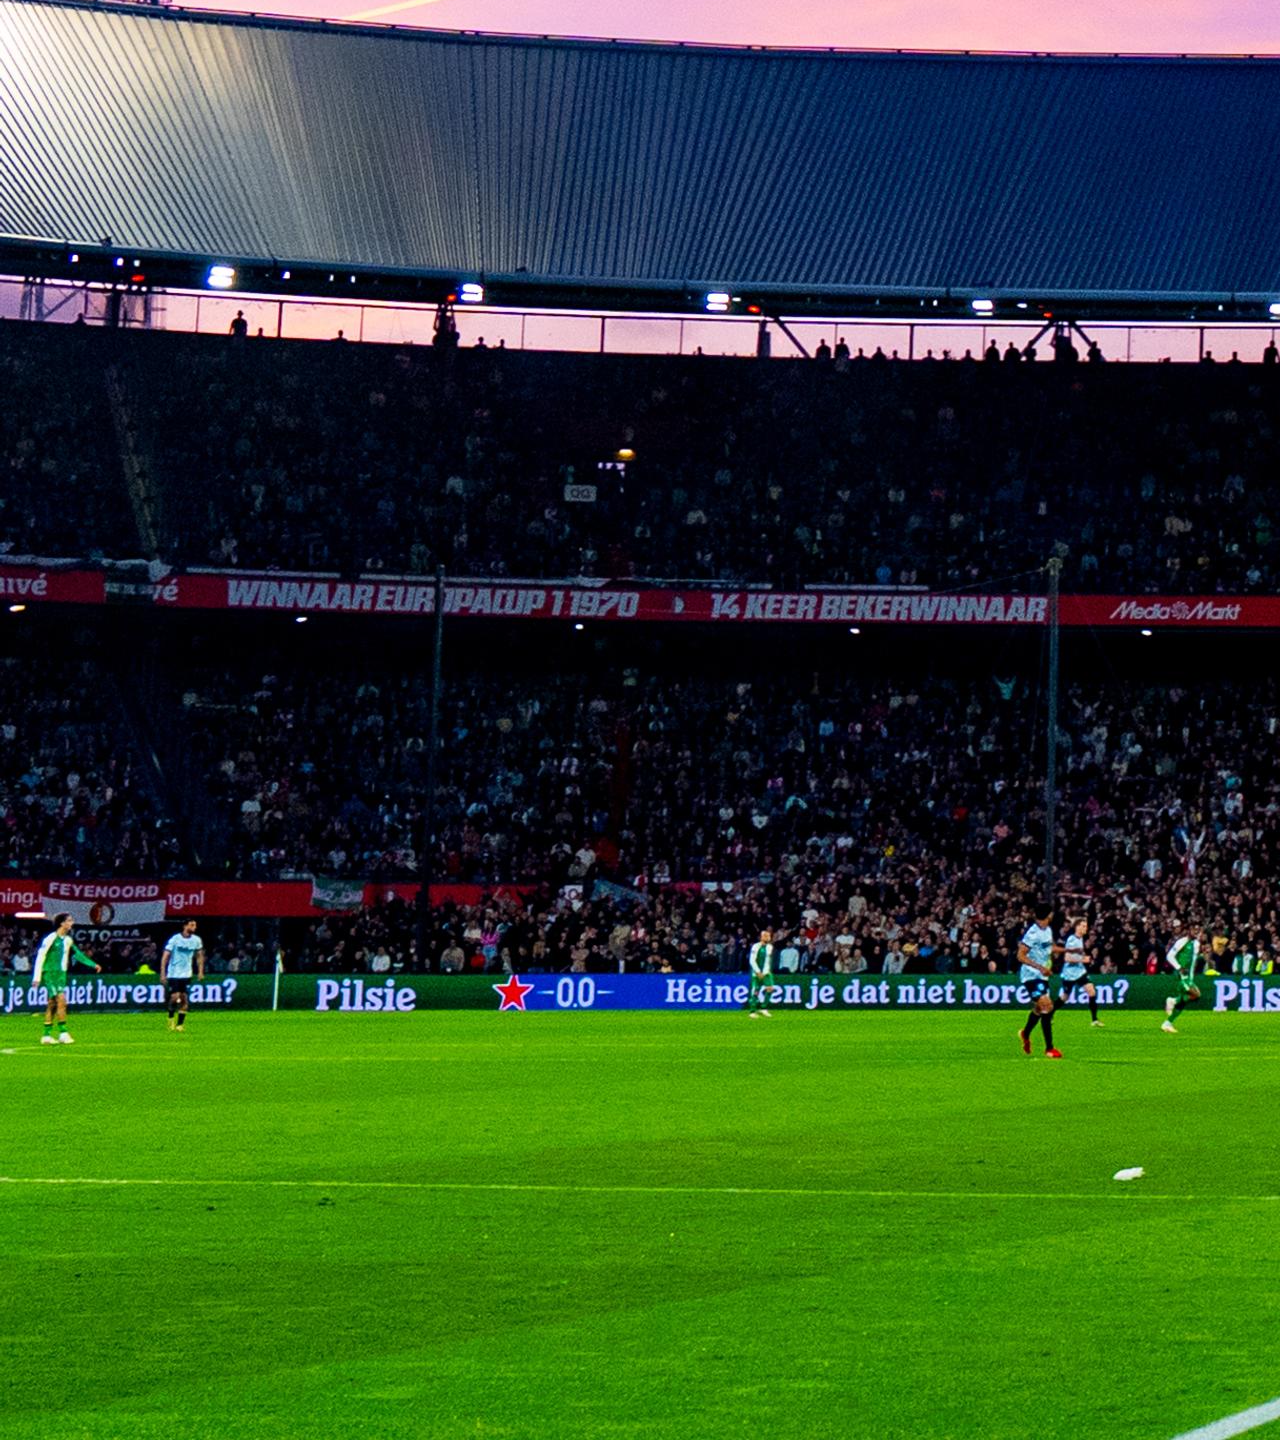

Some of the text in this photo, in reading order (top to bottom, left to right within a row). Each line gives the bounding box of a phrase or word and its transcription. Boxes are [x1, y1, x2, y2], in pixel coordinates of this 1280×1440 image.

[226, 579, 374, 610] WINNAAR
[569, 591, 641, 617] 1970
[710, 593, 1048, 622] 14 KEER BEKERWINNAAR
[48, 881, 160, 899] FEYENOORD
[4, 979, 24, 1012] je
[96, 979, 166, 1004] horen
[187, 978, 238, 1004] an?
[315, 979, 417, 1011] Pilsie
[805, 978, 836, 1010] je
[842, 979, 890, 1004] dat
[897, 978, 955, 1004] niet
[962, 978, 1033, 1004] hore
